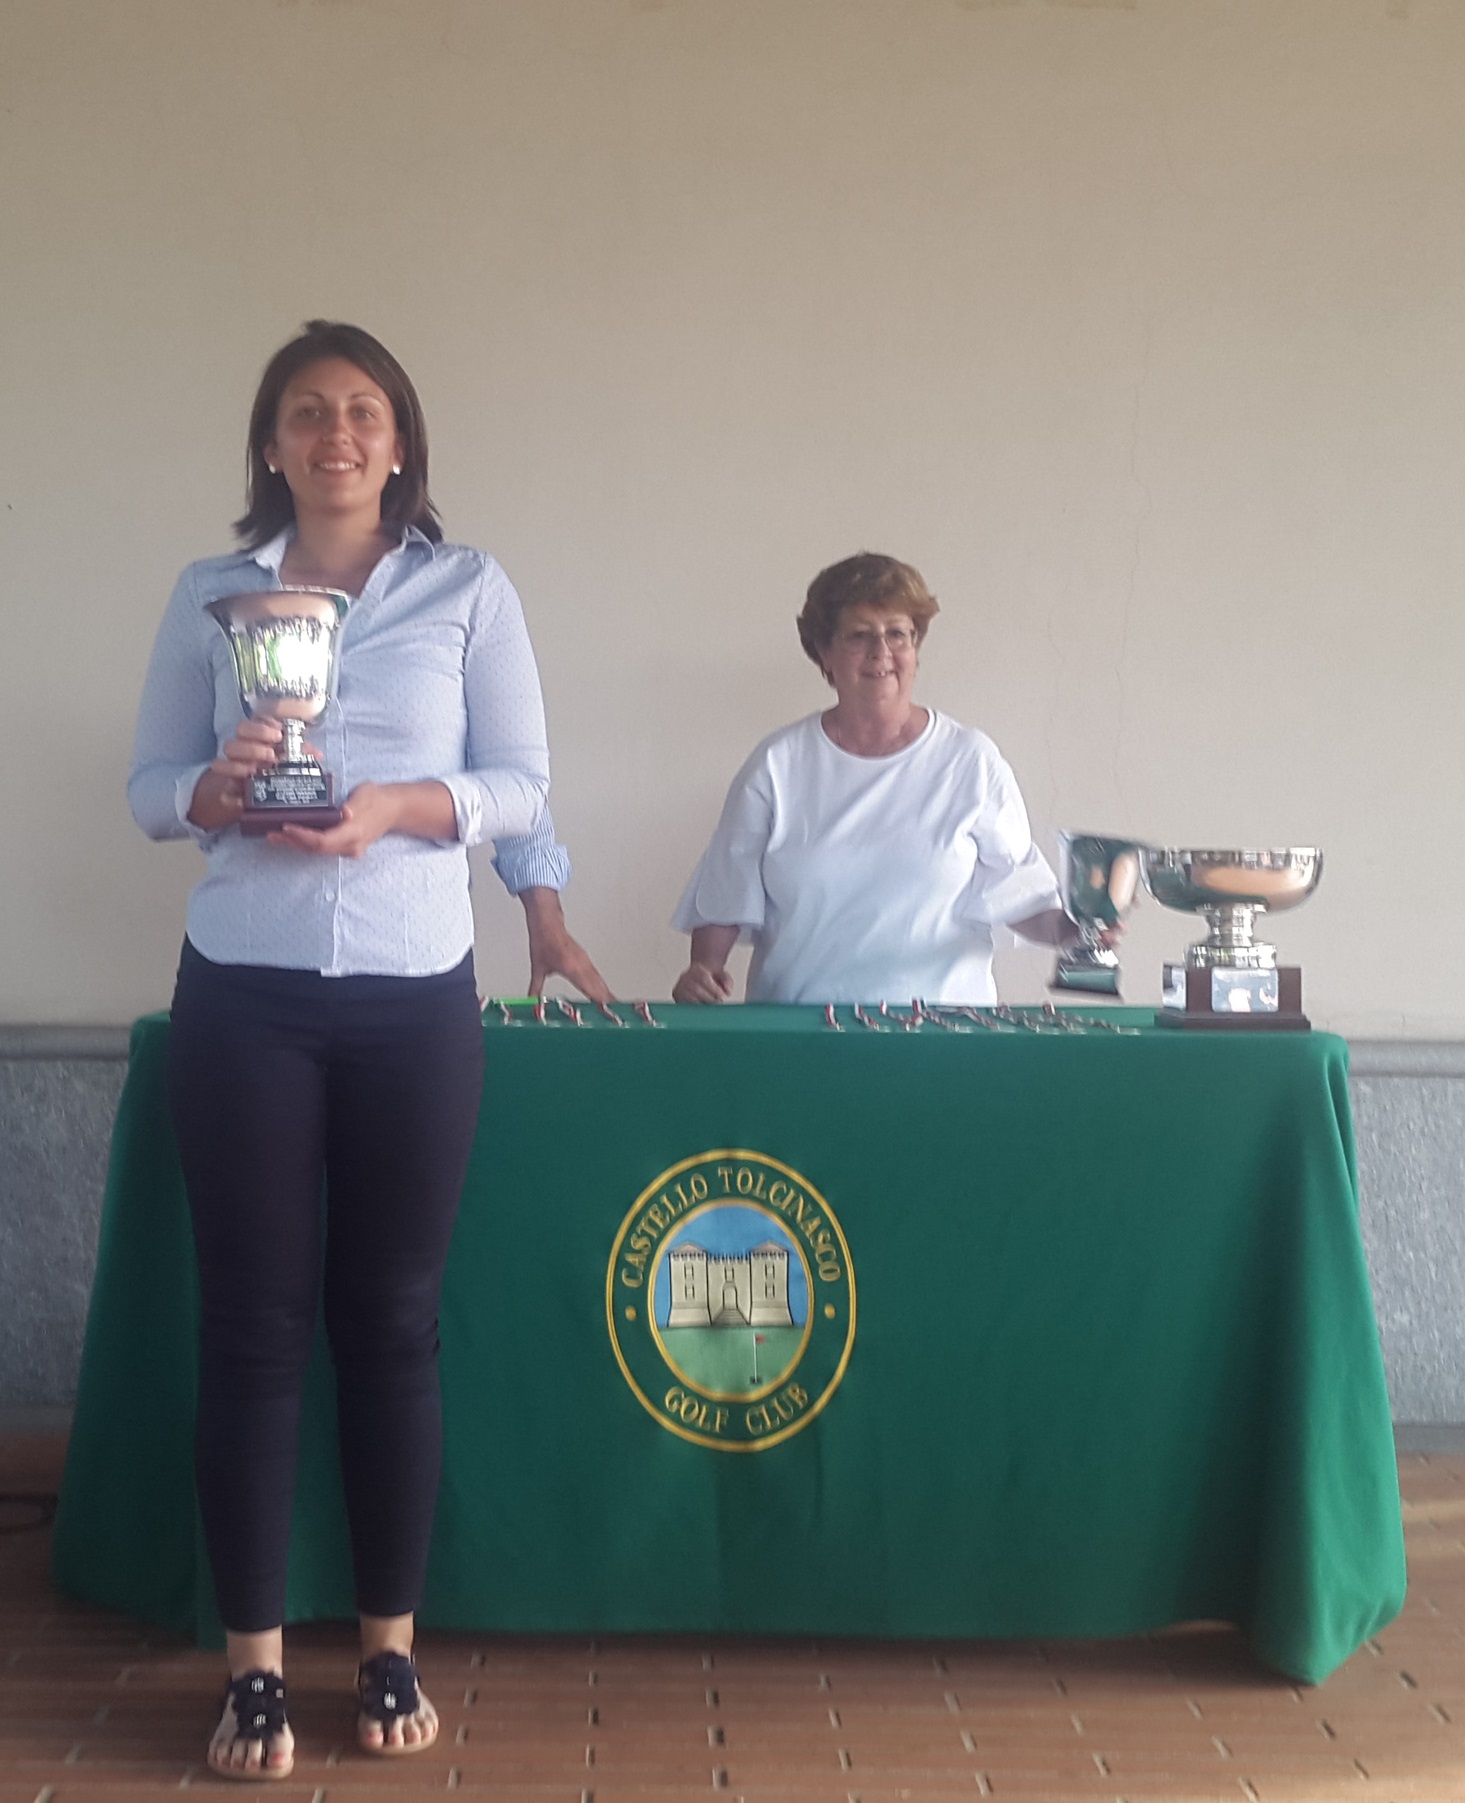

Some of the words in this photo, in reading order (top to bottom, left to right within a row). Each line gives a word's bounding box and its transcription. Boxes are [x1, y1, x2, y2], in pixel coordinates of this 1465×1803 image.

[622, 1173, 708, 1288] CASTELLO
[718, 1166, 841, 1282] TOLCINASCO
[665, 1386, 729, 1433] GOLF
[745, 1383, 808, 1434] CLUB
